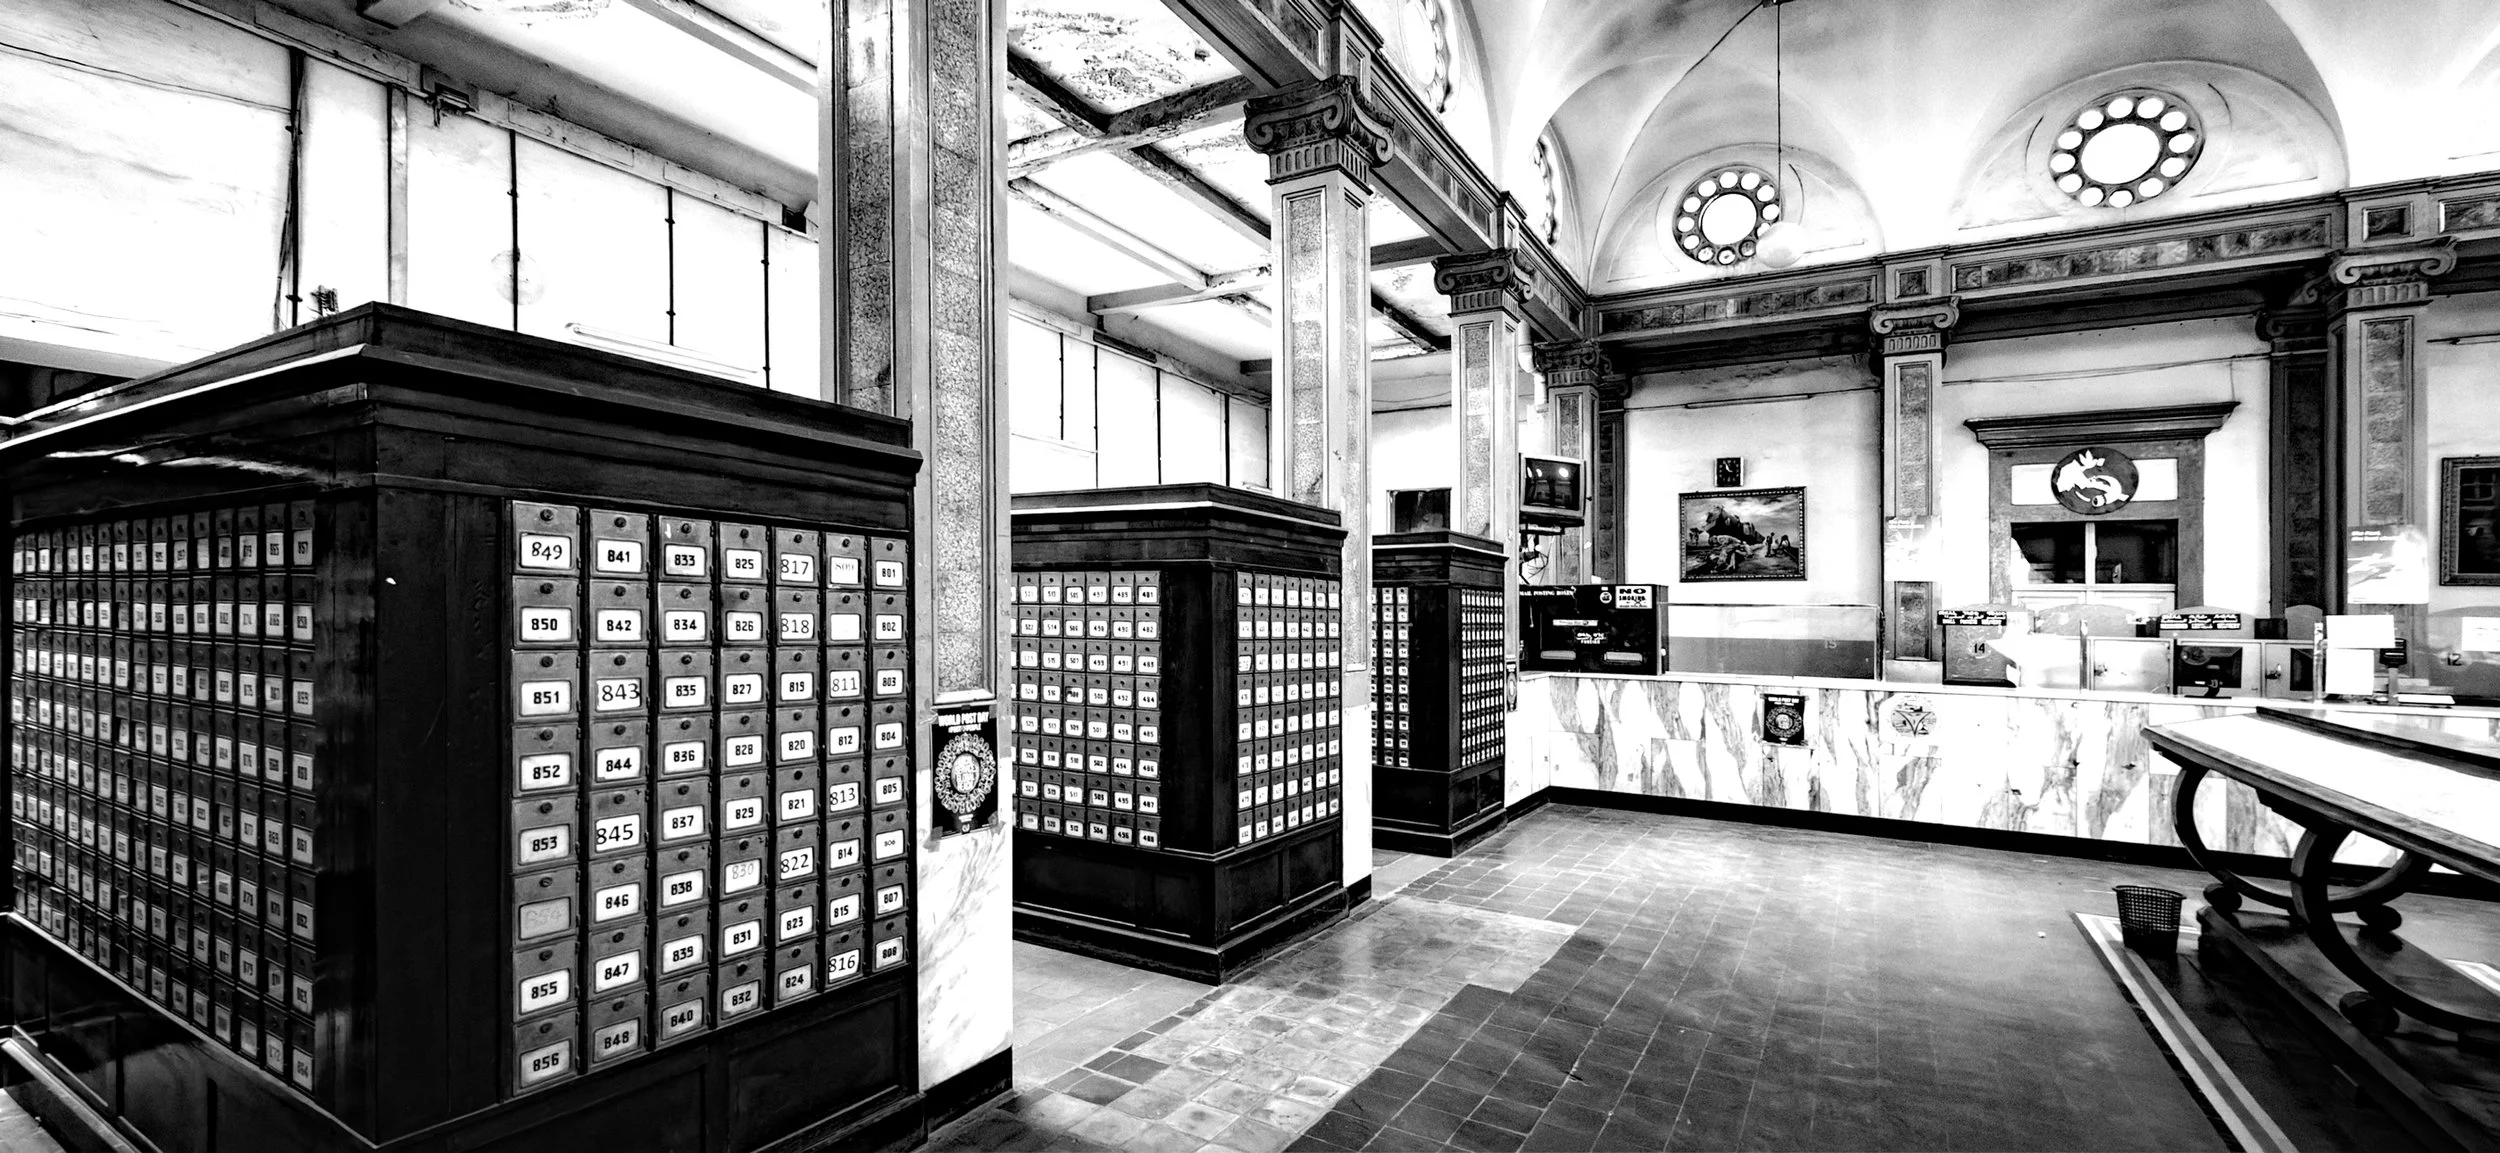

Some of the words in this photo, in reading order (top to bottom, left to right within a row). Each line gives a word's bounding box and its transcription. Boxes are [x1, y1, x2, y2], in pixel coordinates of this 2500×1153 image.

[531, 541, 562, 561] 849
[607, 549, 630, 563] 841
[674, 554, 696, 567] 833
[735, 558, 754, 570] 825
[780, 558, 810, 576] 817
[882, 568, 896, 578] 801
[531, 618, 558, 631] 850
[606, 619, 632, 632] 842
[674, 619, 697, 630] 834
[735, 620, 754, 632] 826
[780, 617, 811, 634] 818
[882, 622, 896, 632] 802
[1974, 643, 1985, 654] 14
[2447, 652, 2462, 666] 12
[831, 677, 858, 692] 811
[882, 676, 896, 687] 803
[601, 682, 641, 702] 843
[676, 684, 696, 697] 835
[732, 683, 752, 695] 827
[533, 690, 559, 705] 851
[961, 712, 977, 725] POST
[977, 711, 989, 723] DAY
[838, 734, 853, 746] 812
[881, 731, 896, 741] 804
[735, 744, 754, 756] 828
[788, 739, 806, 751] 820
[673, 750, 695, 762] 836
[606, 757, 632, 772] 844
[532, 764, 560, 780] 852
[882, 782, 897, 795] 805
[829, 786, 856, 806] 813
[788, 798, 805, 810] 821
[735, 806, 754, 820] 829
[672, 814, 694, 830] 837
[596, 822, 634, 845] 845
[532, 835, 558, 852] 853
[838, 846, 853, 860] 814
[780, 854, 810, 873] 822
[731, 862, 755, 880] 830
[670, 880, 693, 896] 838
[605, 894, 629, 910] 846
[883, 891, 898, 904] 807
[834, 904, 849, 918] 815
[786, 916, 804, 931] 823
[733, 929, 751, 945] 831
[672, 945, 694, 962] 839
[882, 946, 898, 959] 808
[828, 954, 856, 973] 816
[604, 962, 629, 981] 847
[785, 974, 804, 989] 824
[531, 980, 558, 1000] 855
[732, 990, 752, 1006] 832
[670, 1009, 694, 1028] 840
[603, 1031, 630, 1050] 848
[532, 1052, 560, 1072] 856
